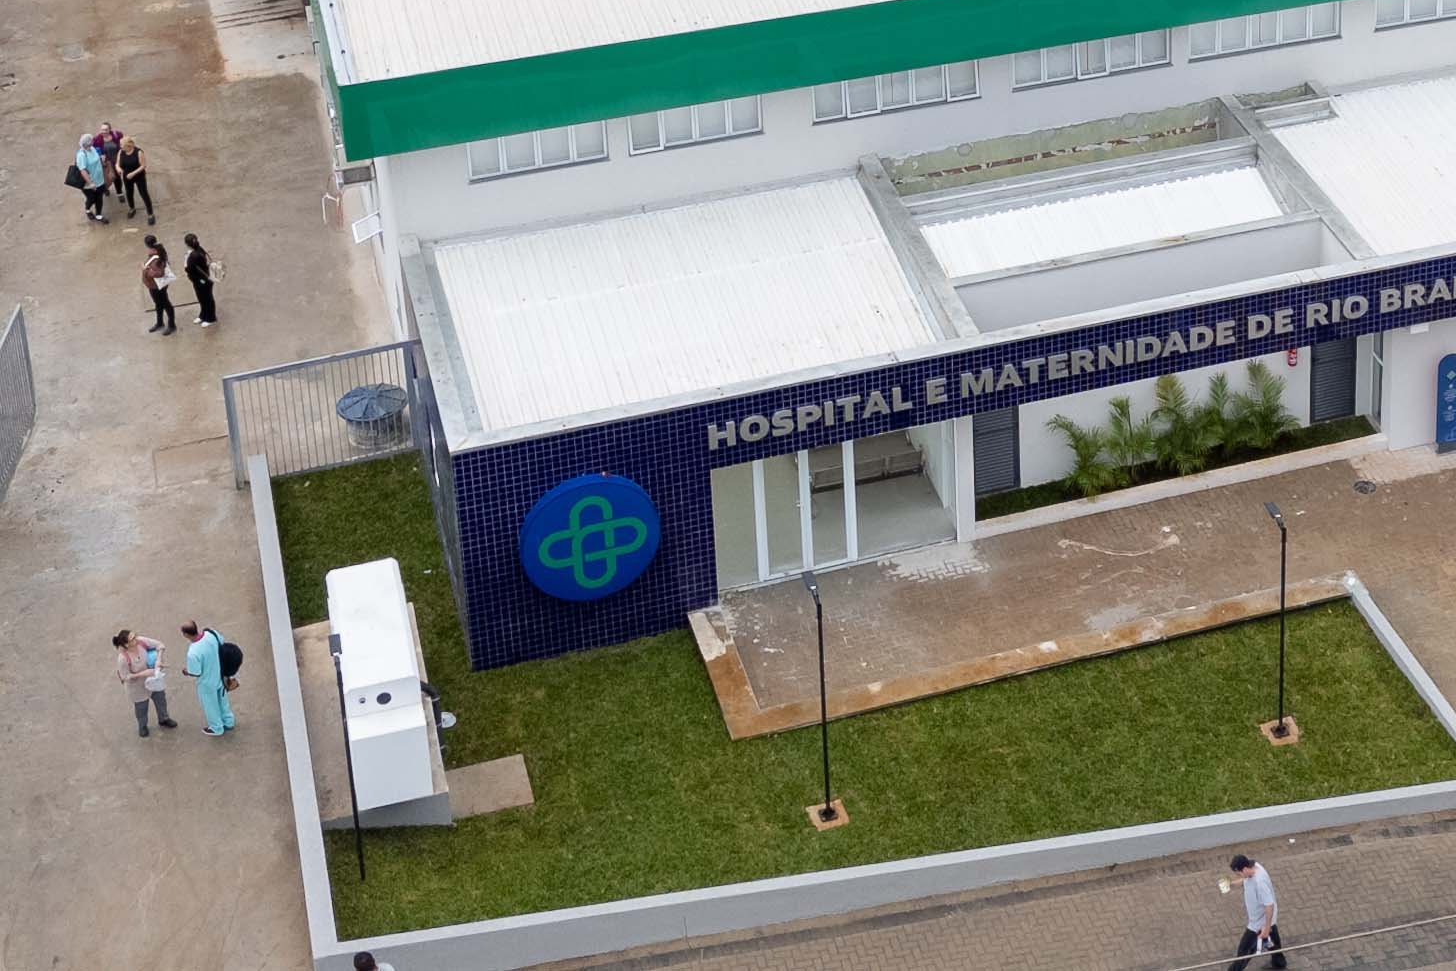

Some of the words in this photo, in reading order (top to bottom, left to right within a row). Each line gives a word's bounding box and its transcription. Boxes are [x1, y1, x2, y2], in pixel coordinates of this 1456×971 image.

[708, 386, 913, 450] HOSPITAL
[926, 377, 949, 405] E
[960, 319, 1236, 398] MATERNIDADE
[1247, 308, 1294, 340] DE
[1306, 294, 1369, 329] RIO
